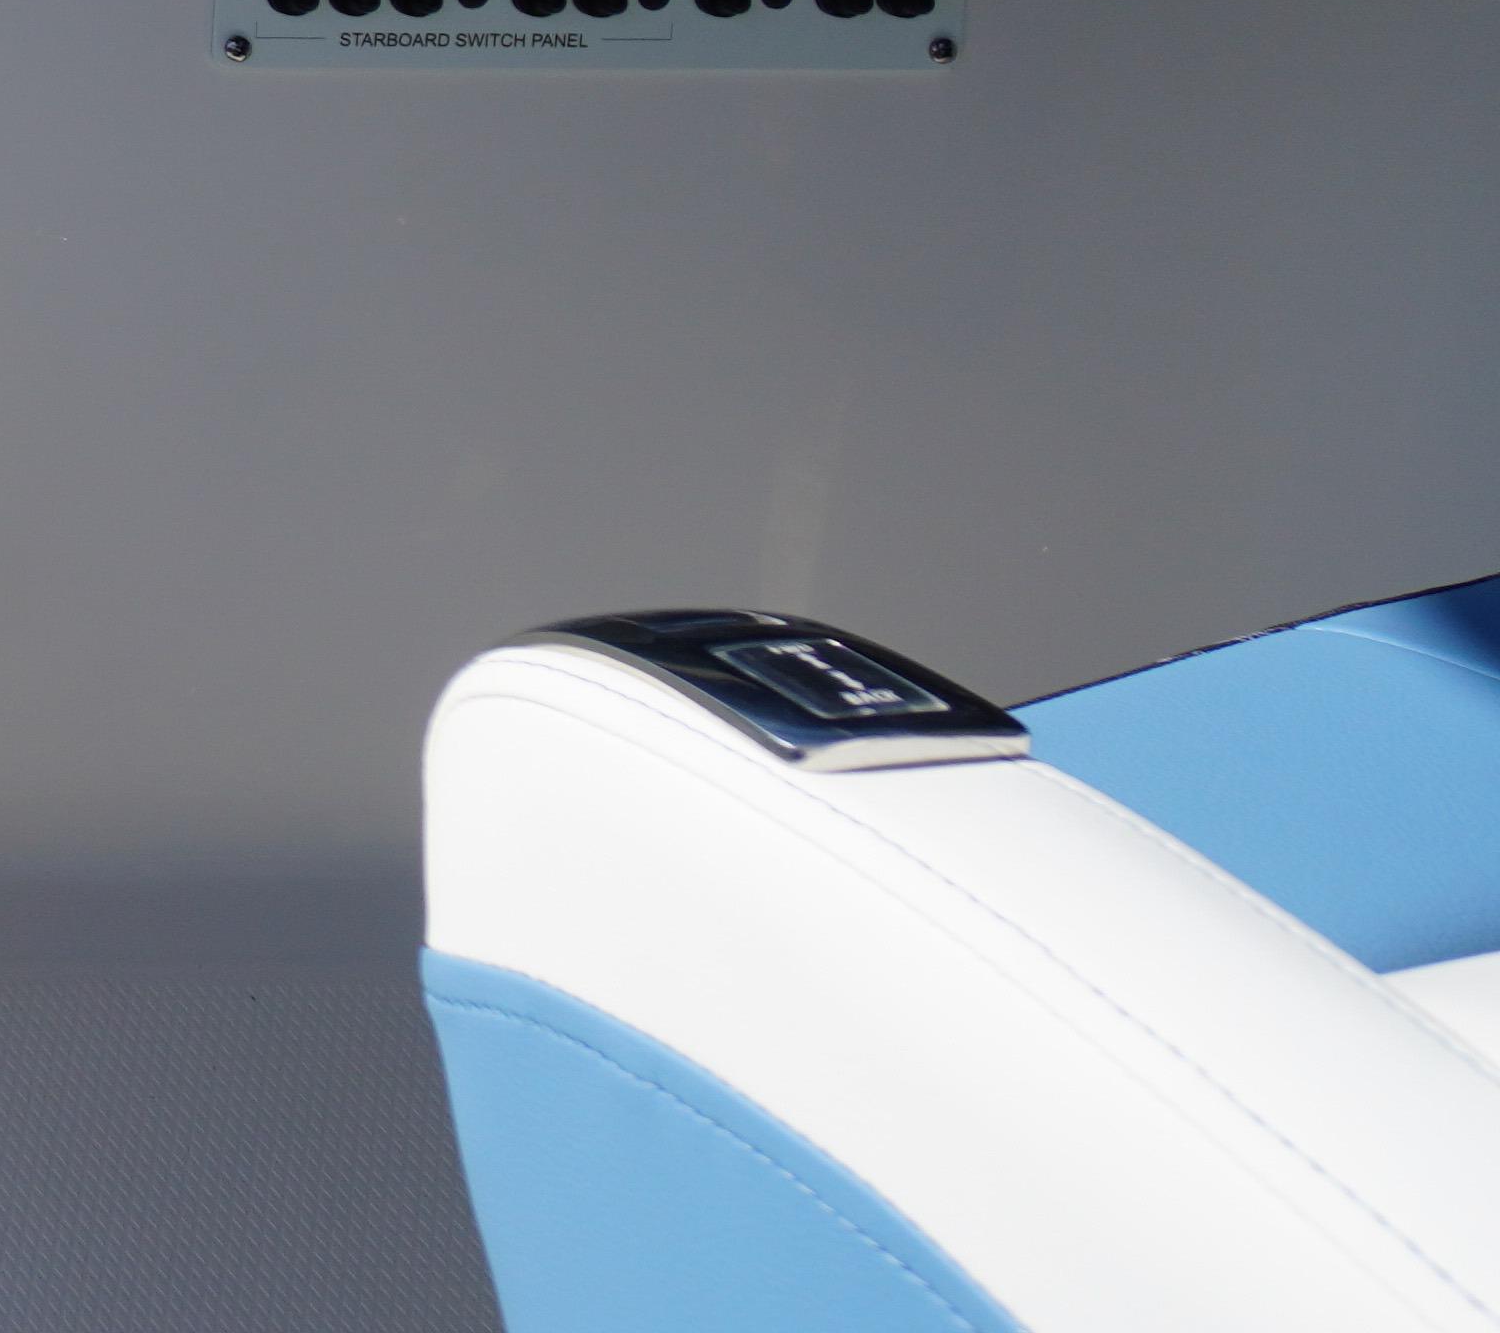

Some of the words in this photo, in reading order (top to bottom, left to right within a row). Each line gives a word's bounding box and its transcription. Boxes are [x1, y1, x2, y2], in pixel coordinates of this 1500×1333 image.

[339, 32, 451, 49] STARBOARD
[456, 32, 526, 50] SWITCH
[531, 32, 589, 49] PANEL
